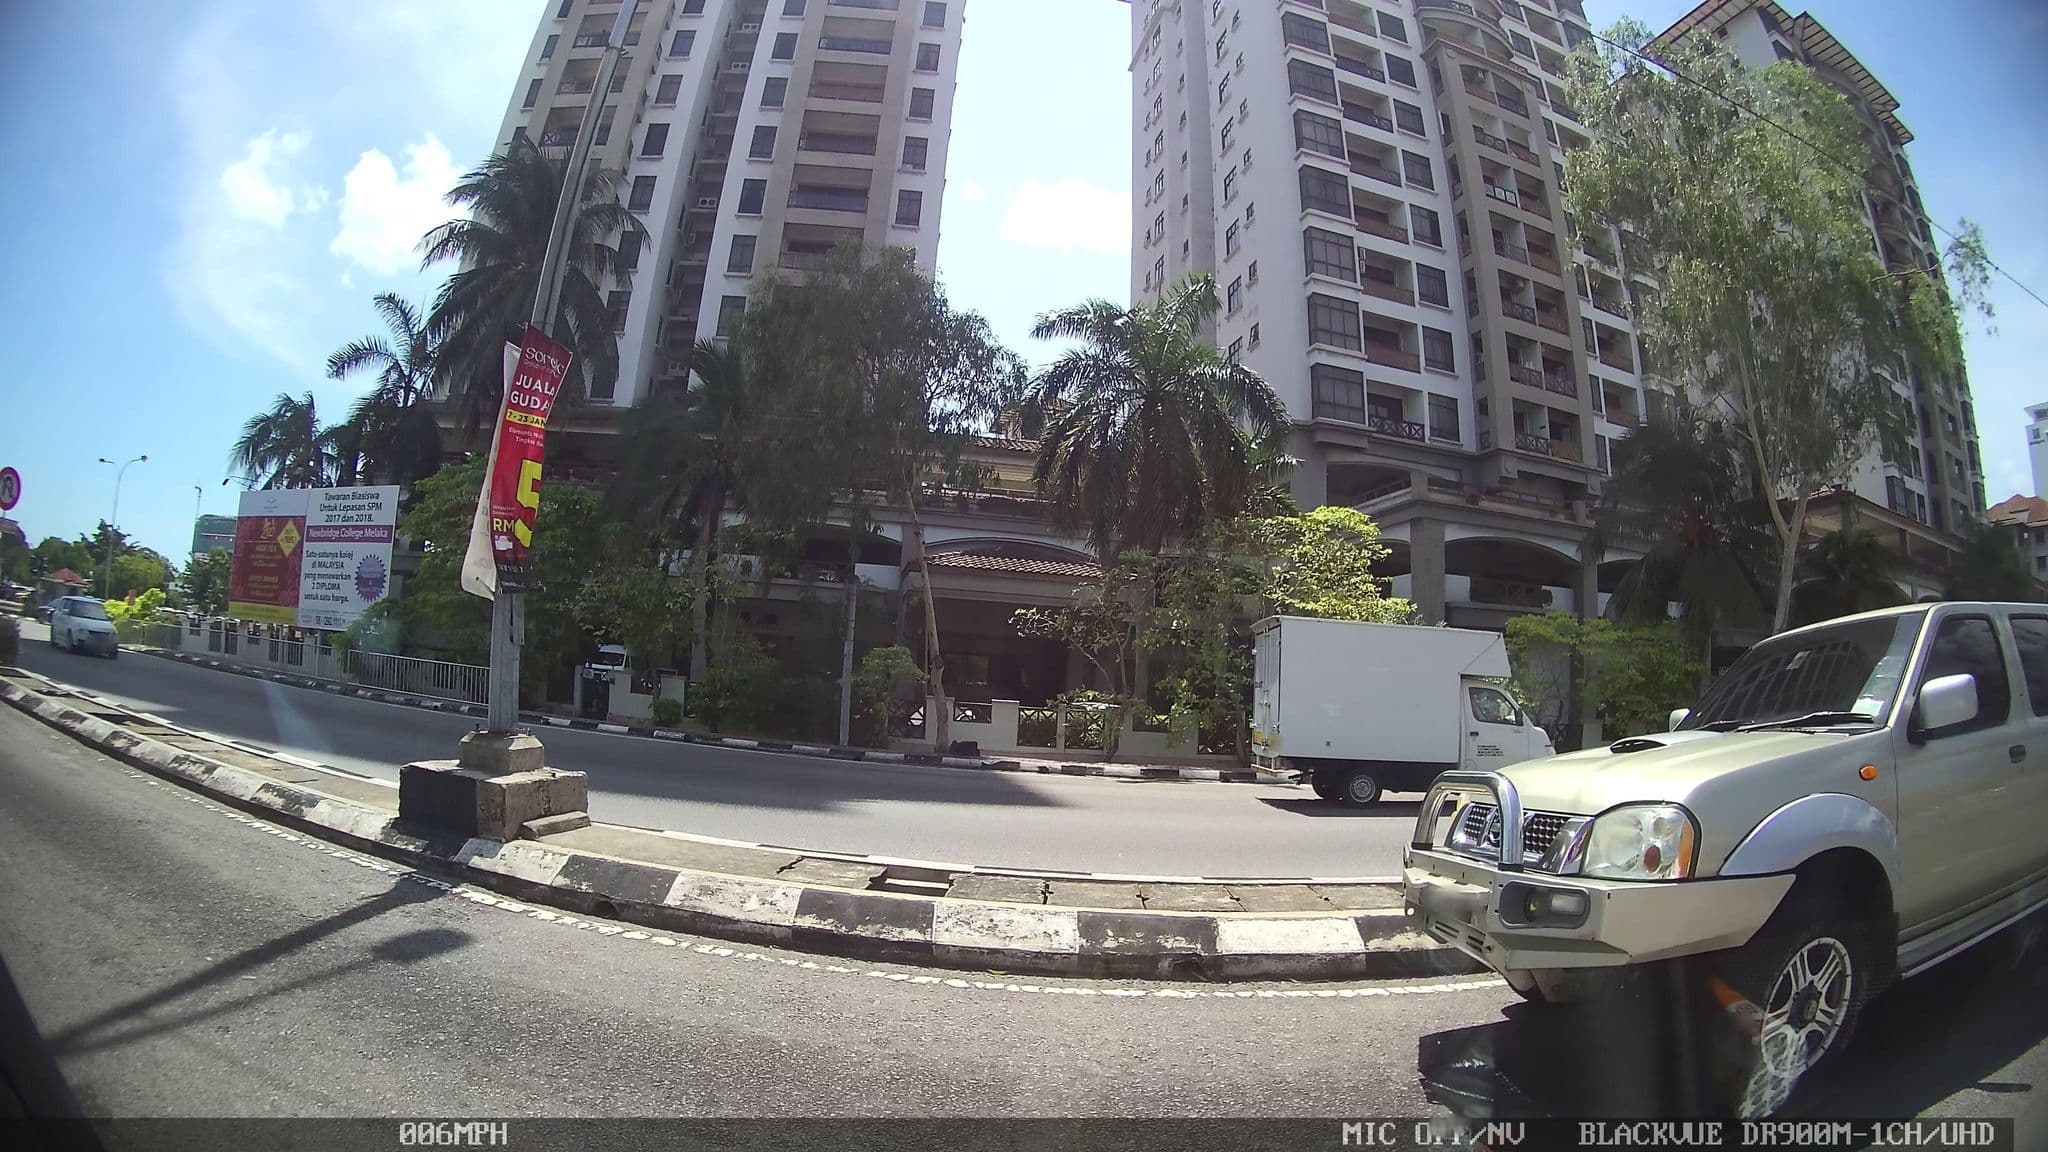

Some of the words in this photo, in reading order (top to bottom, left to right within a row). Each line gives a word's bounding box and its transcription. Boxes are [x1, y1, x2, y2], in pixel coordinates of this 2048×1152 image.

[518, 413, 529, 423] 23
[529, 416, 546, 428] JAN
[324, 492, 350, 501] Tawaran
[351, 491, 380, 500] Biasiswa
[319, 503, 338, 512] Untuk
[339, 503, 366, 513] Lepasan
[367, 502, 382, 511] SPM
[325, 514, 340, 522] 2017
[341, 514, 354, 522] dan
[492, 517, 515, 533] RM
[309, 529, 340, 539] Newbridge
[340, 528, 365, 539] College
[365, 528, 388, 538] Melaka
[340, 550, 354, 560] kolej
[317, 561, 345, 569] MALAYSIA
[304, 573, 316, 581] yang
[317, 572, 352, 580] menawarkan
[316, 582, 341, 590] DIPLOMA
